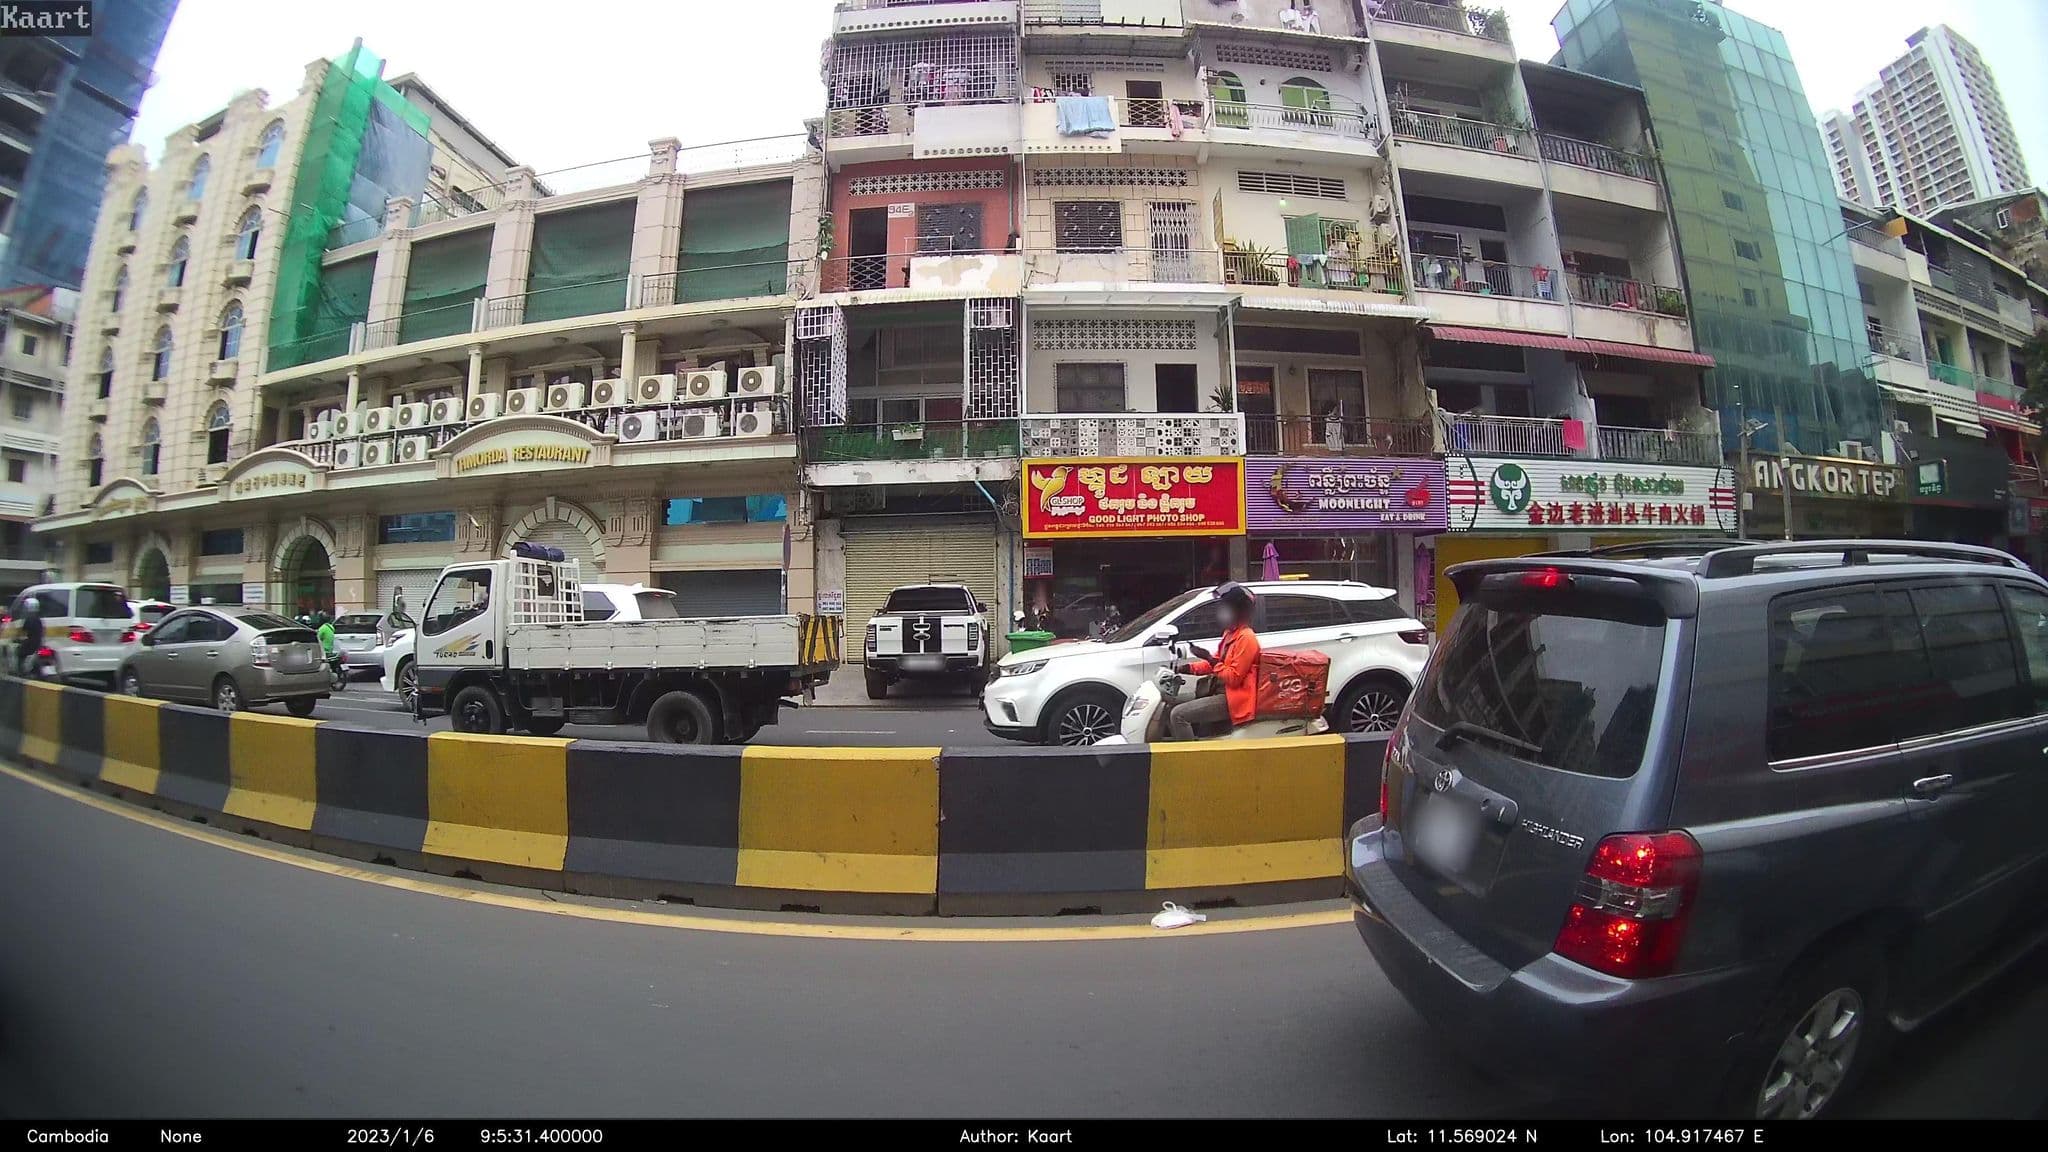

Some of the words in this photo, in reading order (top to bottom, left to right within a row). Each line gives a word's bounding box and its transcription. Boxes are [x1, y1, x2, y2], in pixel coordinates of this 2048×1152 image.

[512, 444, 592, 464] RESTAURANT
[1755, 460, 1855, 494] ANGKOR
[1858, 470, 1895, 496] TEP
[1318, 498, 1391, 510] MOONLIGHT
[1088, 515, 1116, 523] GOOD
[1117, 514, 1145, 523] LIGHT
[1147, 514, 1178, 522] PHOTO
[1180, 513, 1205, 522] SHOP
[1380, 513, 1394, 521] EAT
[1403, 512, 1426, 521] DRINK
[1521, 818, 1585, 850] HIGHLANDER
